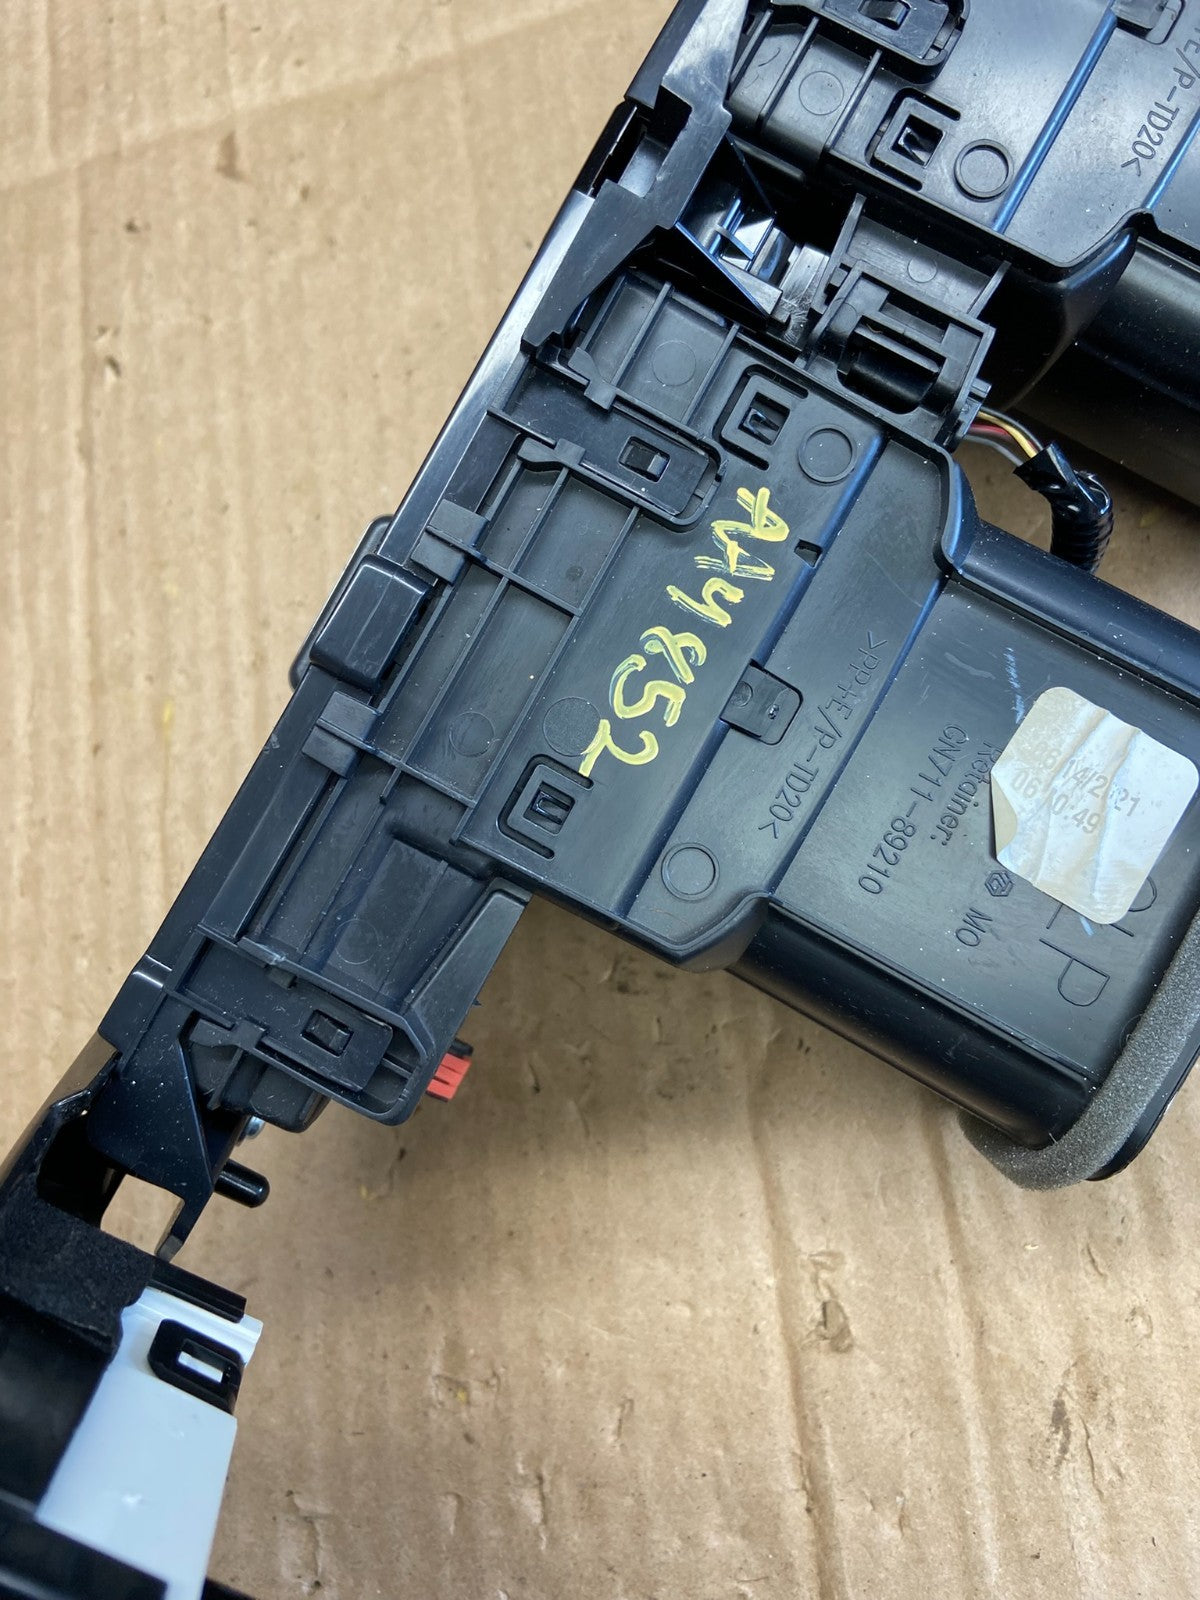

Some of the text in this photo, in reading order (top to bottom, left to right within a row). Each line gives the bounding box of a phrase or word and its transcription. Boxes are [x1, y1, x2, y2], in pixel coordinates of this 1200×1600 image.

[758, 631, 888, 839] >PP+E/P-TD20<
[858, 724, 968, 895] GN711-89210
[930, 742, 1002, 846] Retainer:
